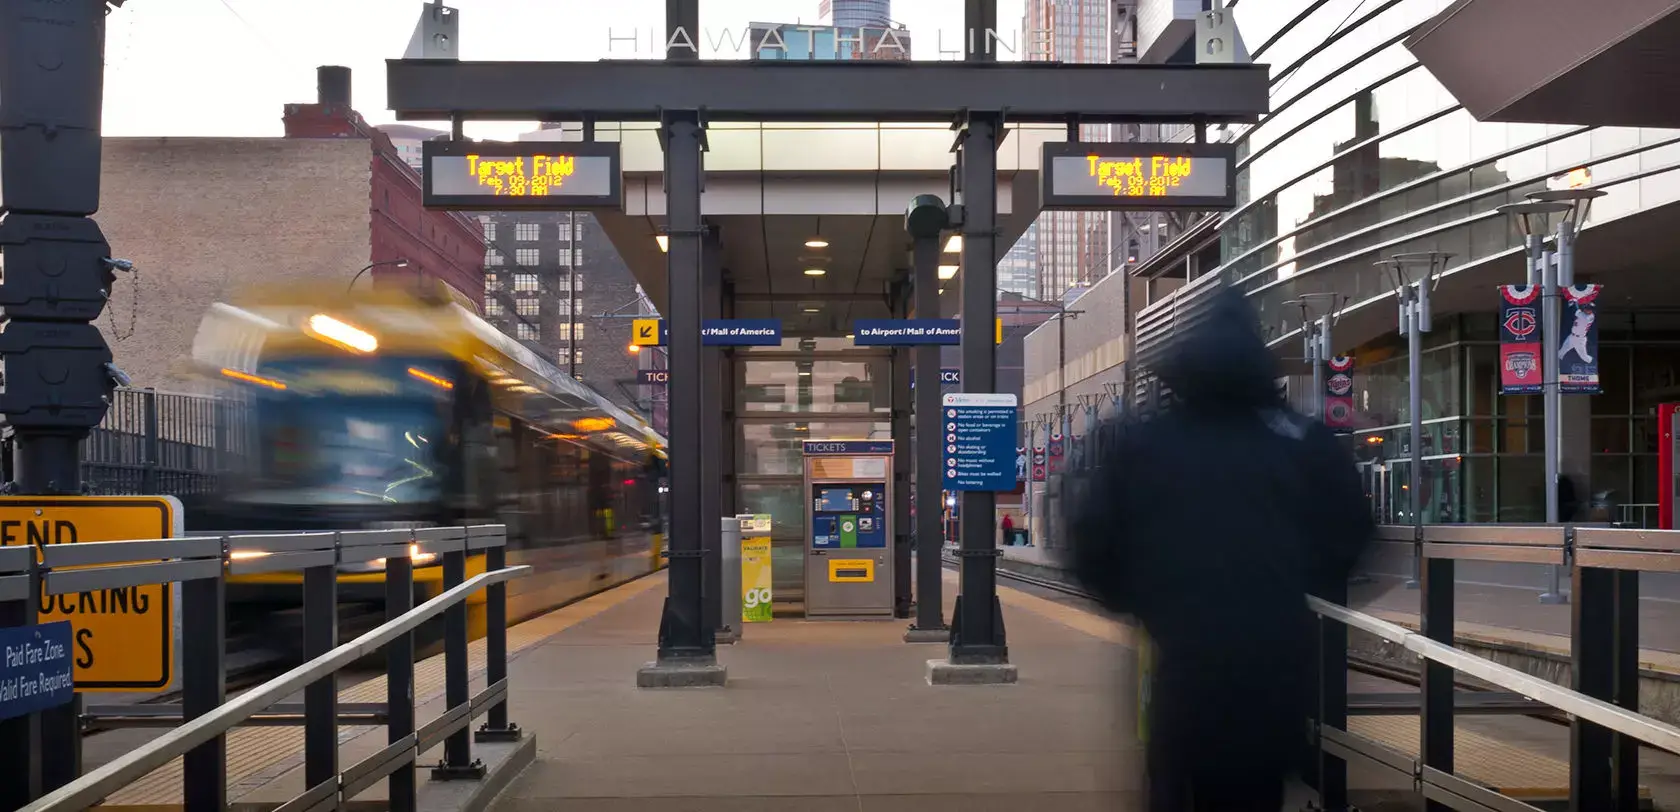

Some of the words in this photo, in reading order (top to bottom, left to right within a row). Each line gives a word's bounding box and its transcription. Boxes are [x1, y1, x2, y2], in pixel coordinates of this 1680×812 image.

[609, 27, 906, 54] HIAWATHA
[939, 27, 1050, 54] LINE
[466, 155, 525, 176] Target
[533, 155, 575, 177] Field
[1086, 156, 1143, 177] Target
[1151, 156, 1192, 177] Field
[478, 175, 503, 186] Feb
[1098, 177, 1121, 187] Feb
[495, 186, 525, 196] 7:30
[530, 186, 548, 196] AM
[1113, 187, 1144, 196] 7:30
[1149, 187, 1167, 196] AM
[871, 328, 902, 337] Airport
[808, 443, 846, 451] TICKETS
[744, 588, 772, 608] go
[6, 644, 24, 668] Paid
[25, 643, 43, 664] Fare
[20, 675, 38, 698] Fare
